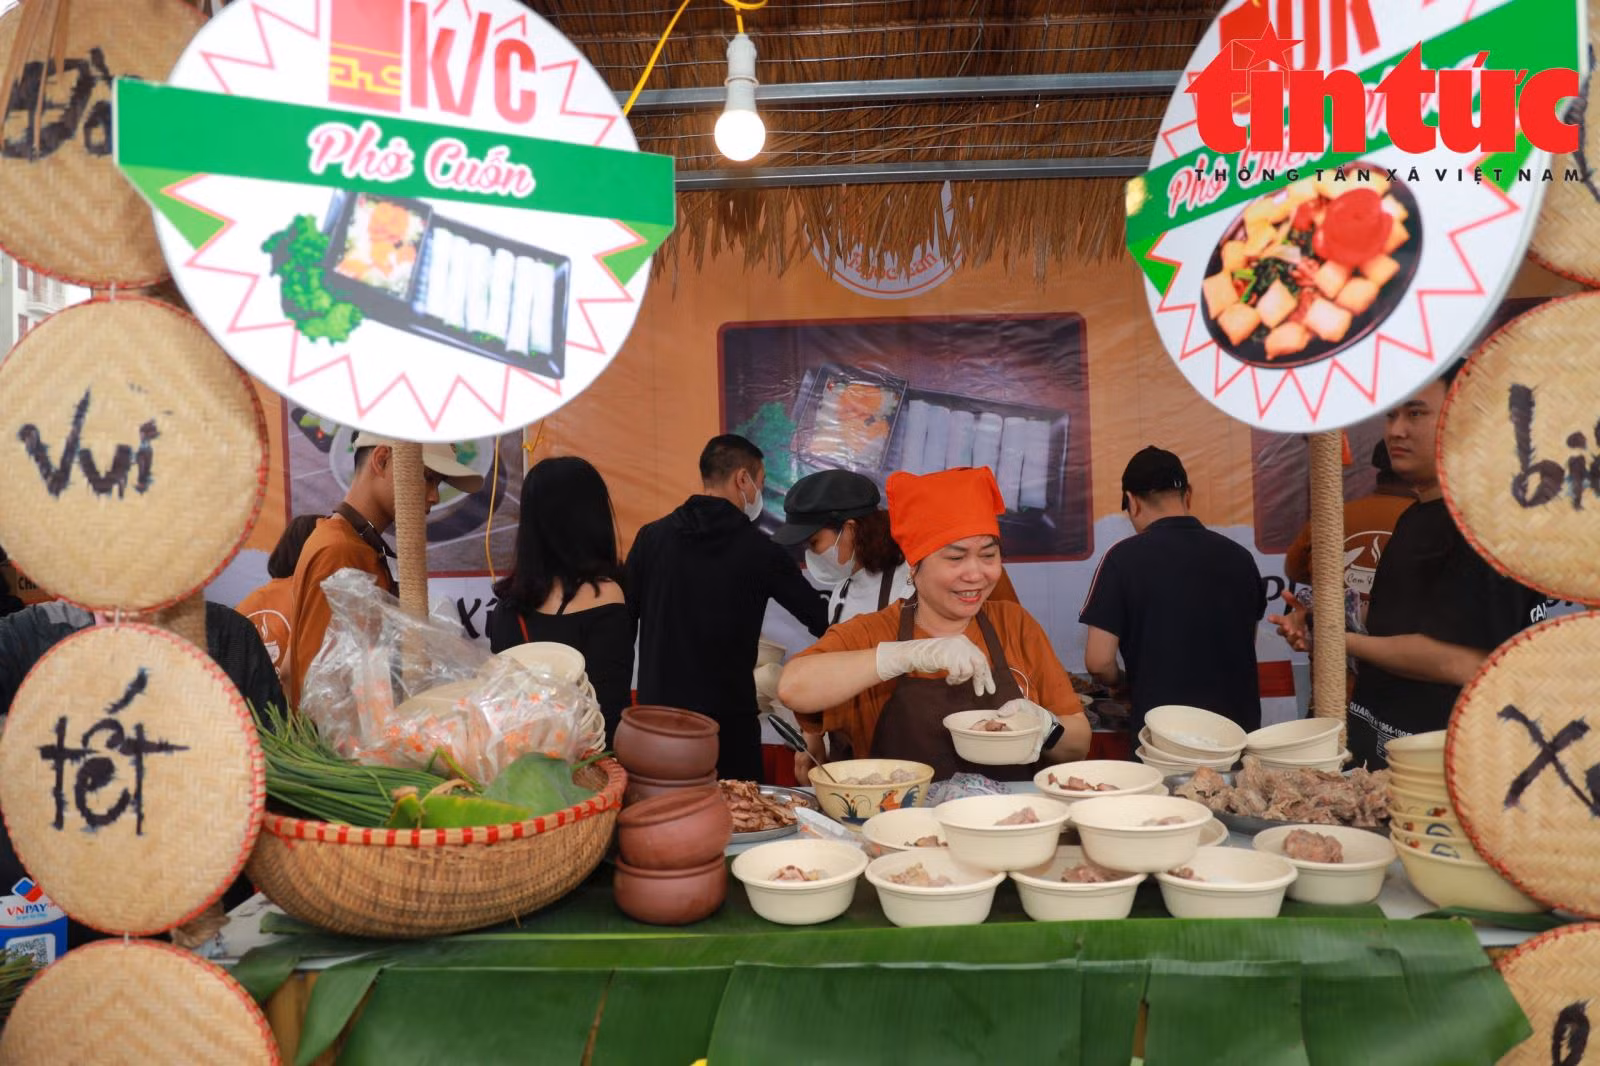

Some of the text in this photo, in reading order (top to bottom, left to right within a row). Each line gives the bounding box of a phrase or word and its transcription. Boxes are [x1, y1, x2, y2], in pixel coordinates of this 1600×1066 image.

[307, 121, 536, 198] Phở Cuốn
[17, 384, 160, 499] Vui
[37, 667, 191, 837] tết
[7, 903, 48, 917] VNPAY
